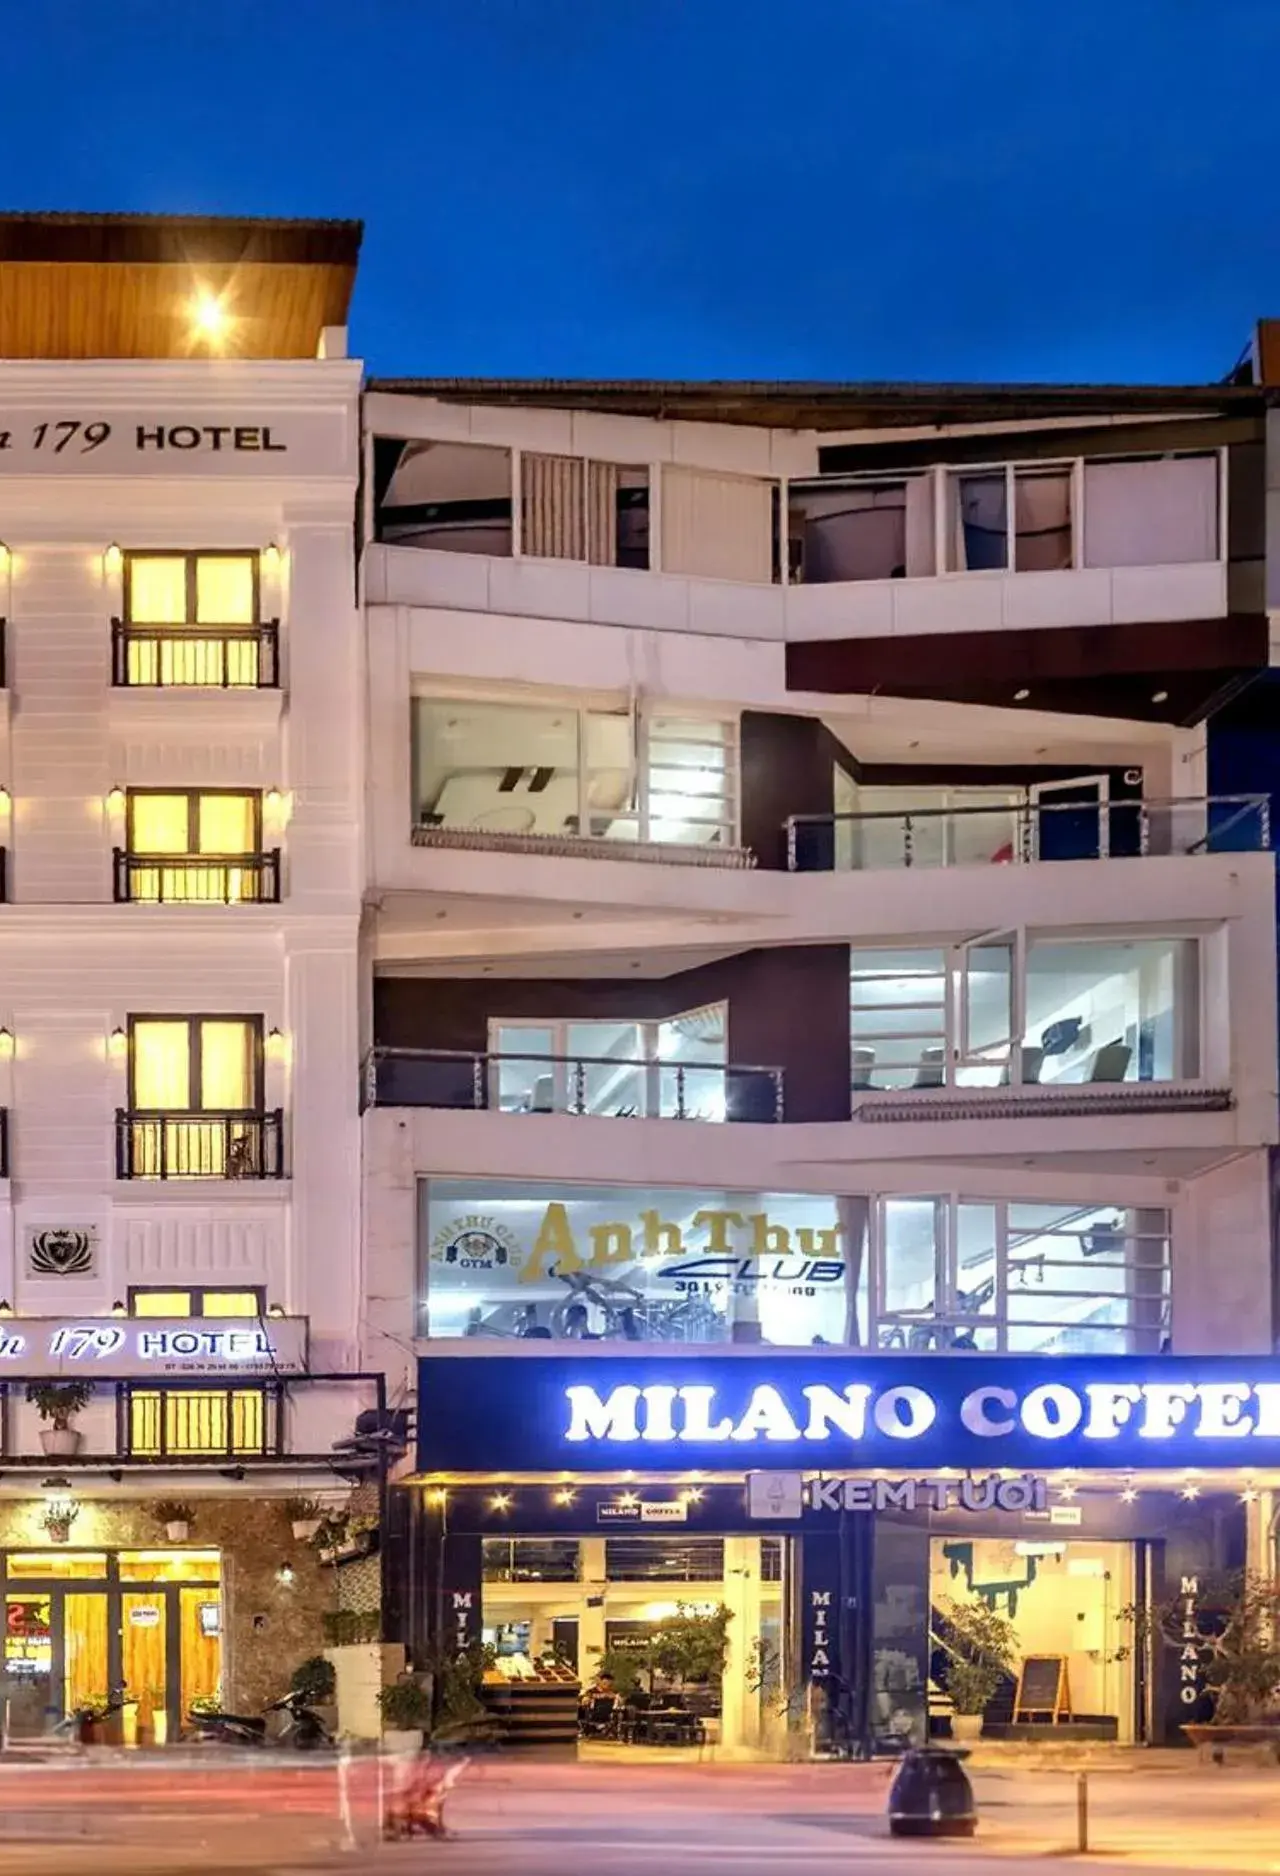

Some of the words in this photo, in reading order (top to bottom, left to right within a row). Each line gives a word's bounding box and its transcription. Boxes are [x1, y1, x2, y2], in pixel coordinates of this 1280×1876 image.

[31, 421, 112, 454] 179
[137, 425, 287, 451] HOTEL
[460, 1259, 493, 1269] GYM
[658, 1258, 846, 1282] CLUB
[50, 1326, 124, 1359] 179
[142, 1330, 277, 1358] HOTEL
[564, 1384, 937, 1441] MILANO
[811, 1478, 916, 1511] KEM
[920, 1472, 1047, 1511] TƯƠI
[1180, 1575, 1199, 1705] MILANO
